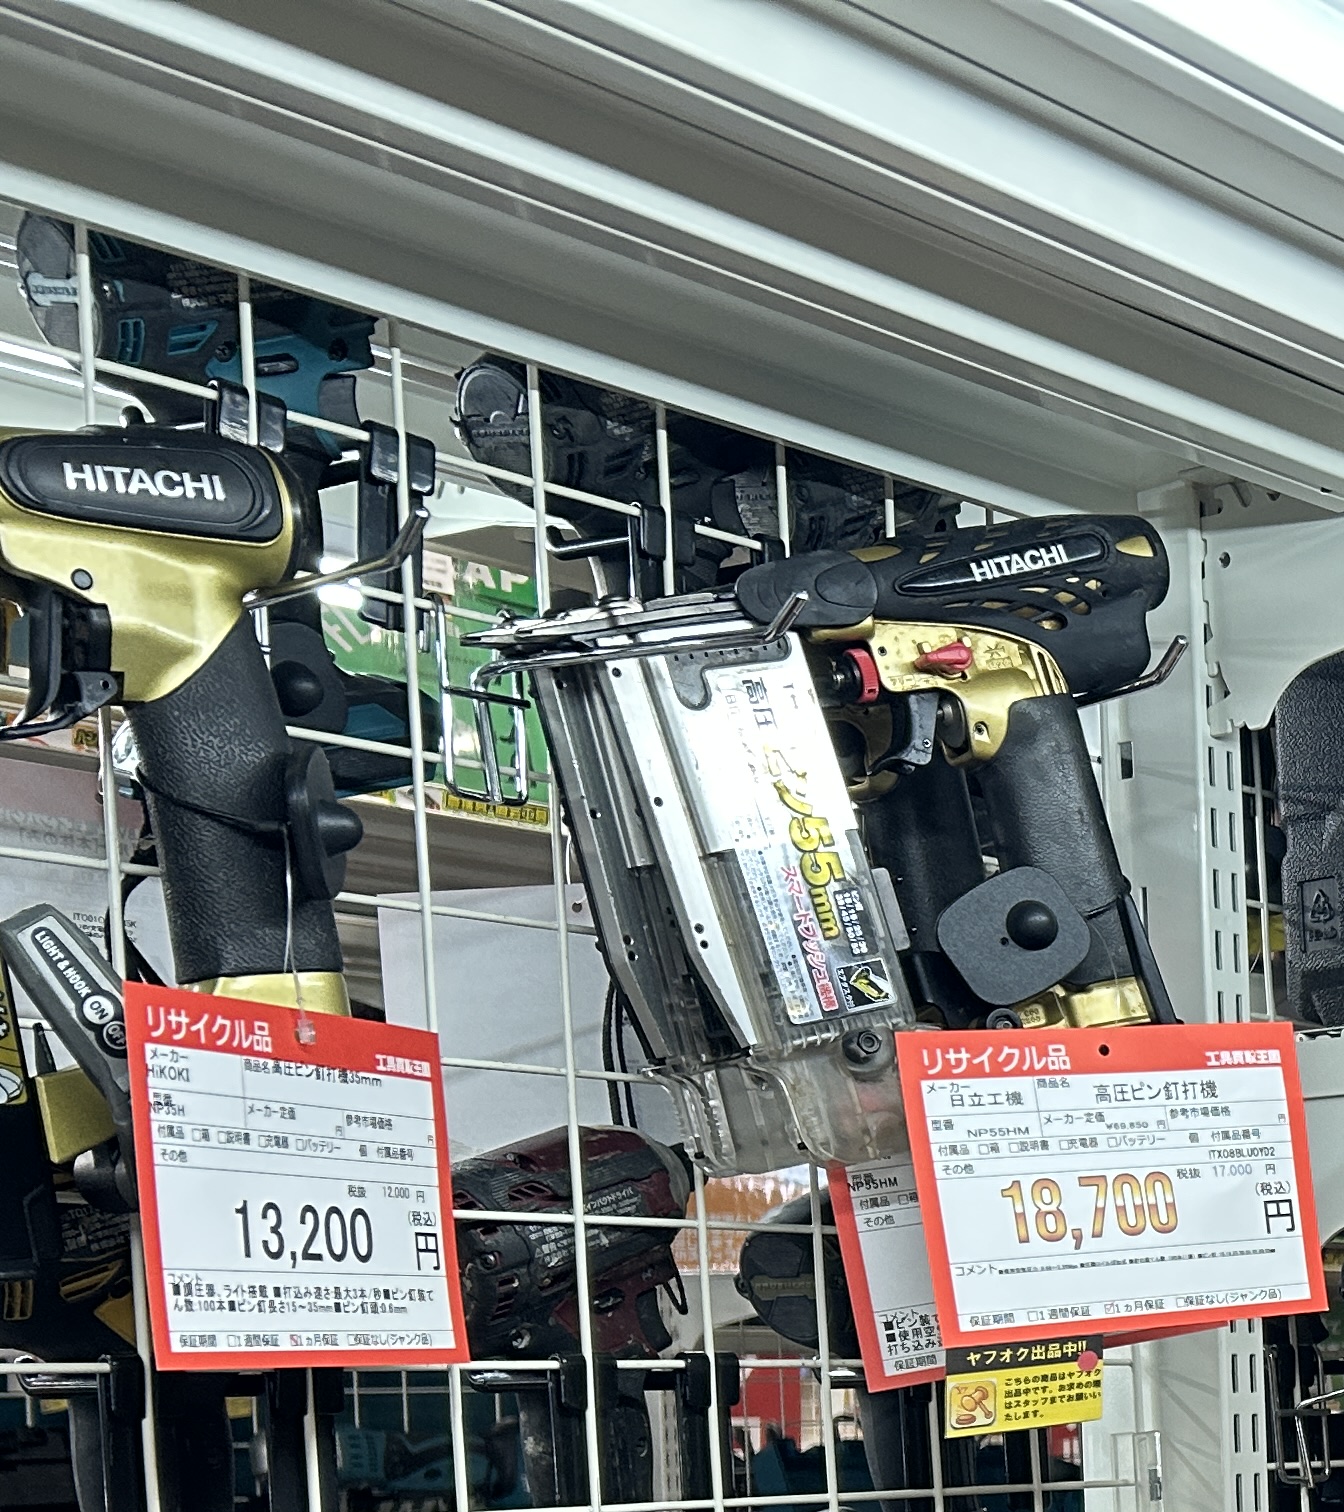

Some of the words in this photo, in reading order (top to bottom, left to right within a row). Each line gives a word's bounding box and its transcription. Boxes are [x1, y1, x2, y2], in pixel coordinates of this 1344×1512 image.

[63, 461, 226, 502] HITACHI
[970, 543, 1070, 583] HITACHI
[34, 931, 64, 961] LIGHT
[63, 967, 92, 998] HOOK
[89, 1000, 109, 1020] ON
[147, 1005, 272, 1053] リサイクル品
[150, 1048, 189, 1063] メーカー
[922, 1044, 1071, 1075] リサイクル品
[147, 1064, 190, 1082] HiKOKI
[927, 1082, 970, 1094] メーカー
[1036, 1077, 1070, 1089] 商品名
[1093, 1080, 1219, 1104] 高圧ピン釘打機
[950, 1091, 1024, 1107] 日立工機
[1043, 1112, 1105, 1125] メーカー定価
[1169, 1105, 1231, 1119] 参考市場価格
[967, 1126, 1030, 1138] NP55HM
[938, 1144, 970, 1157] 付属品
[1116, 1134, 1166, 1147] バッテリー
[942, 1163, 975, 1175] その他
[1265, 1164, 1276, 1175] 円
[1255, 1181, 1291, 1196] (税込)
[1000, 1171, 1179, 1251] 18,700
[1264, 1199, 1295, 1235] 円
[864, 1214, 895, 1228] その他
[234, 1200, 374, 1269] 13,200
[415, 1232, 440, 1271] 円
[955, 1264, 998, 1277] コメント
[969, 1312, 1015, 1327] 保証期間
[966, 1340, 1088, 1367] ヤフオク出品中!!
